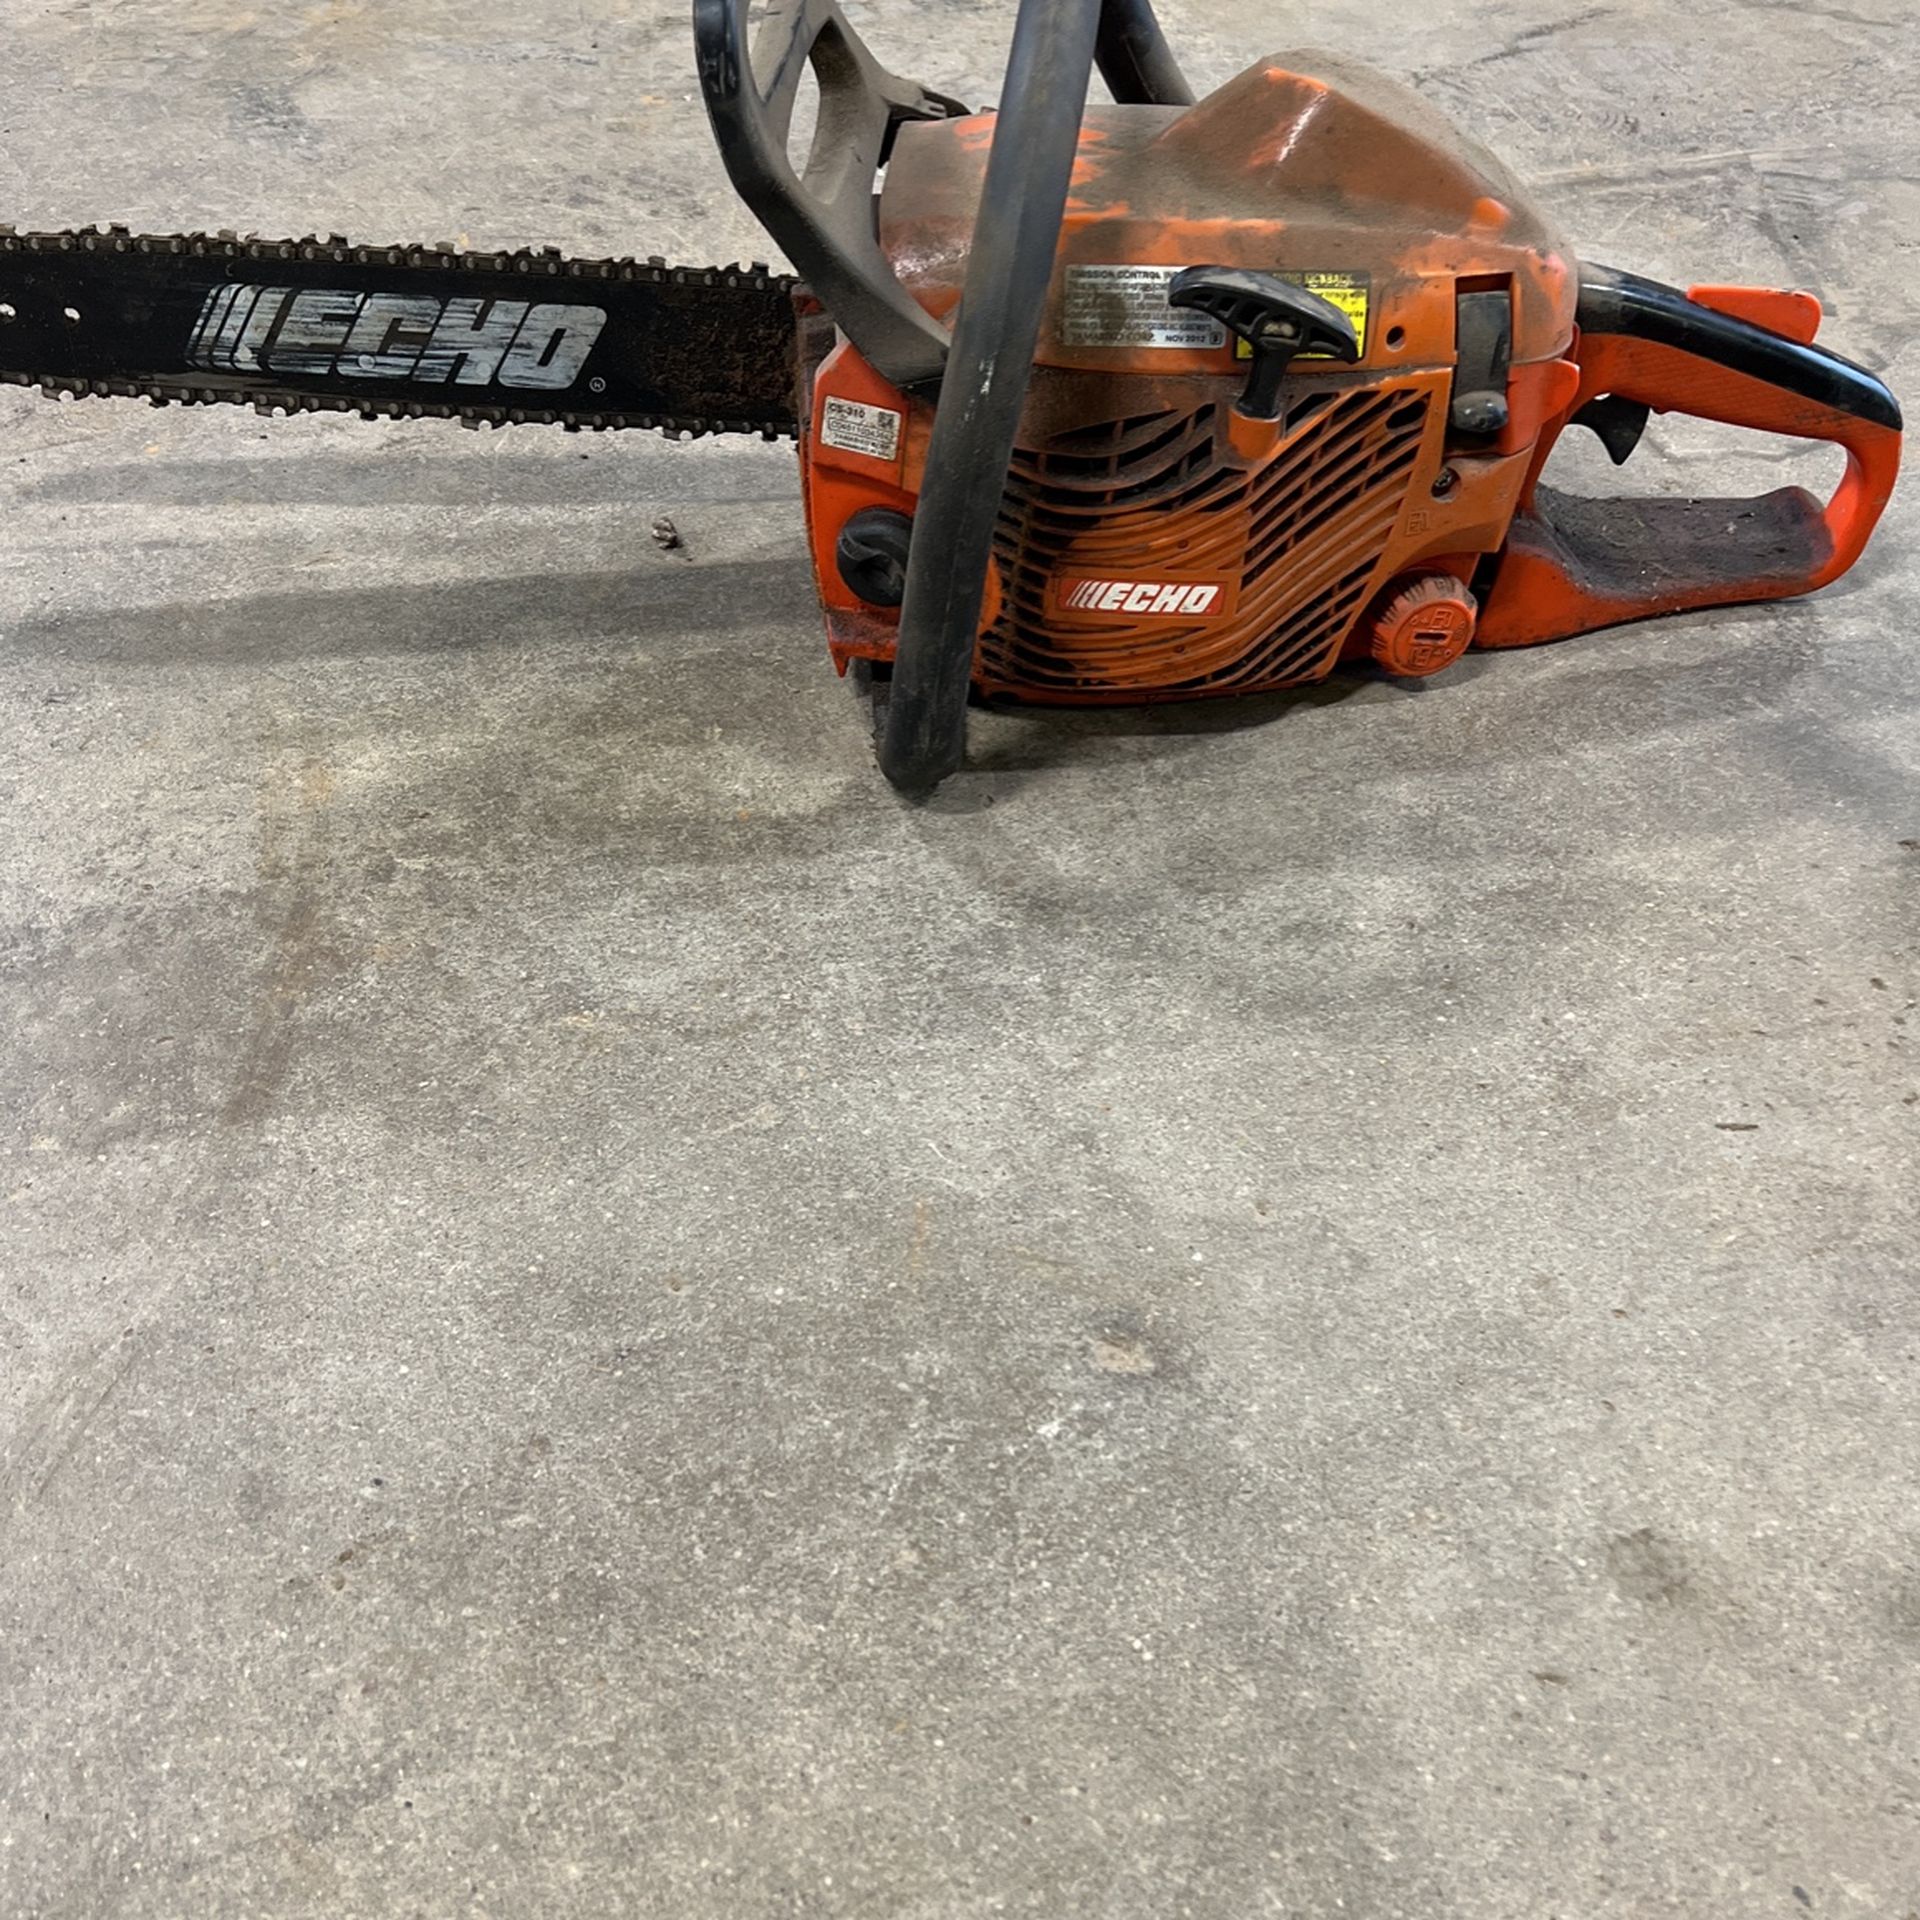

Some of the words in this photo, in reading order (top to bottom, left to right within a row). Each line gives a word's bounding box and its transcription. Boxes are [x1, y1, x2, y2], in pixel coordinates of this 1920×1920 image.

[1117, 269, 1161, 279] CONTROL
[265, 288, 608, 390] ECHO
[1165, 334, 1184, 343] NOV
[829, 403, 865, 418] CS-310
[1097, 581, 1219, 614] ECHO
